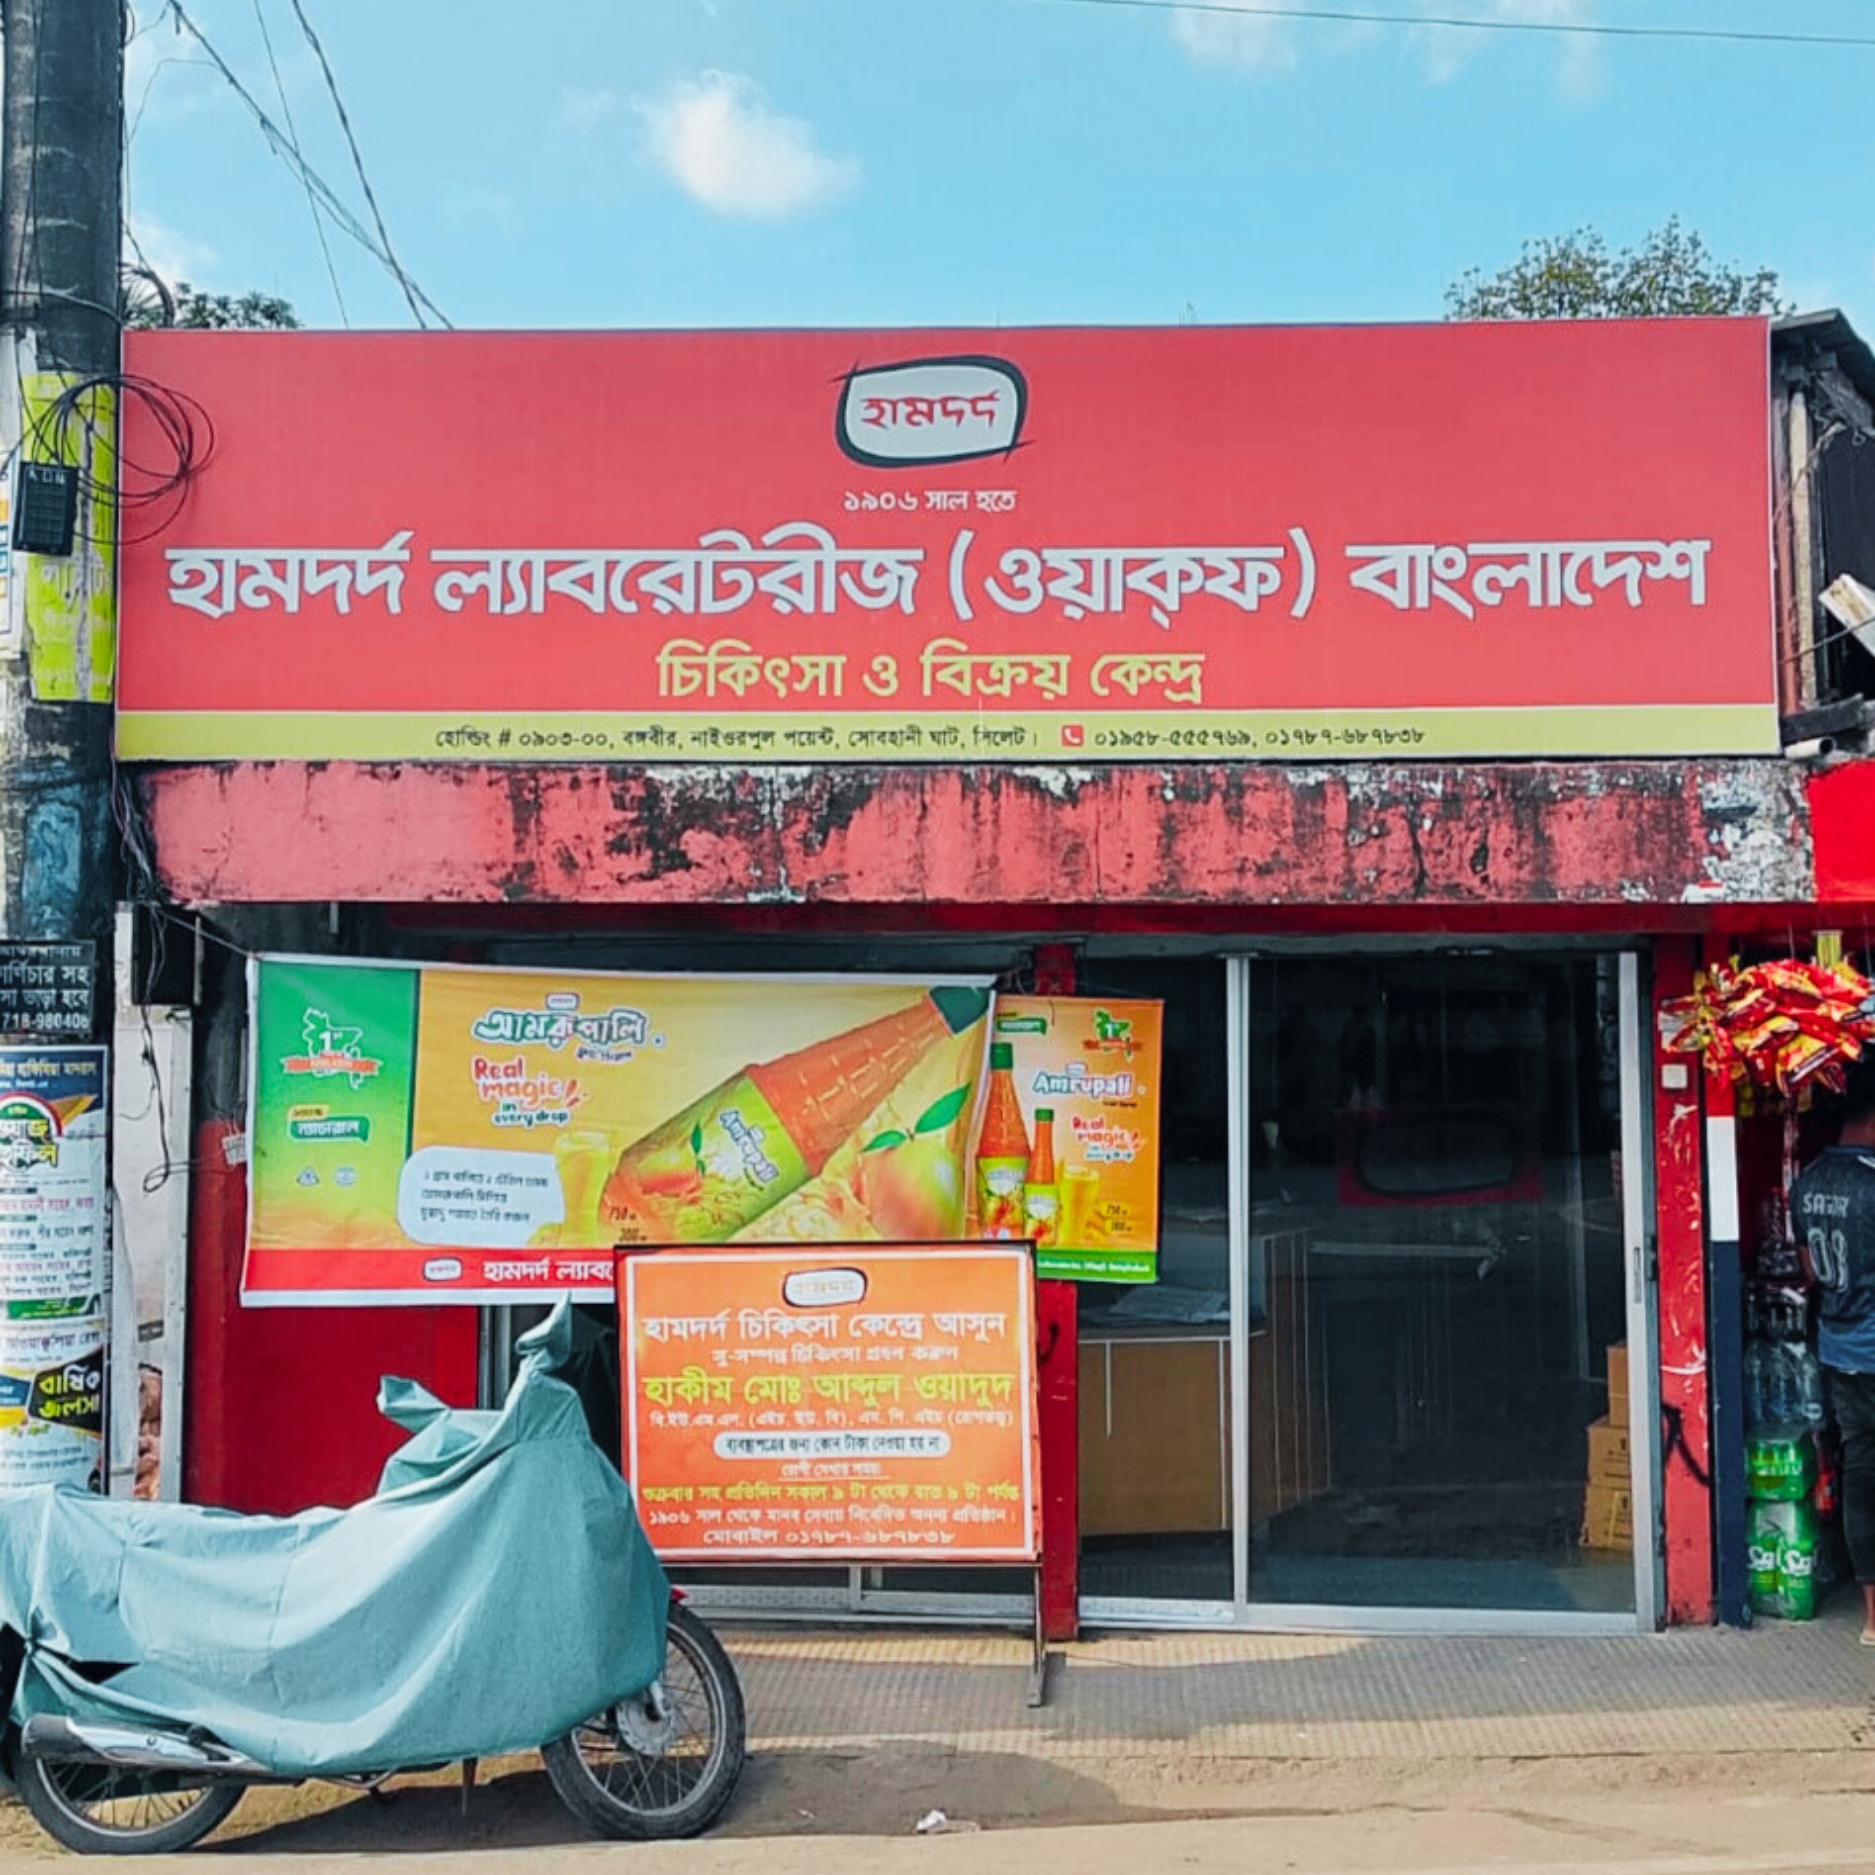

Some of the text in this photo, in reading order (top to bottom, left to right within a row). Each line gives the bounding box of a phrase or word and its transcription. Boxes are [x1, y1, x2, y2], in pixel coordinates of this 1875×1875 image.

[860, 389, 1001, 430] হামদর্দ
[844, 489, 1018, 512] ১৯০৬ সাল হতে
[166, 531, 413, 618] হামদর্দ
[430, 521, 924, 616] ল্যাবরেটরীজ
[1346, 539, 1712, 619] বাংলাদেশ
[656, 637, 1206, 704] চিকিৎসা ও বিক্রয় কেন্দ্র
[928, 725, 966, 750] ঘাট,
[474, 1057, 523, 1081] Real
[1033, 1070, 1132, 1099] Amrupali
[483, 1256, 551, 1282] হামদর্দ
[641, 1308, 731, 1343] হামদর্দ
[848, 1311, 925, 1341] কেন্দ্রে
[931, 1311, 1008, 1343] আসুন
[641, 1366, 1016, 1411] হাকীম মোঃ আব্দুল ওয়াদুদ
[702, 1527, 778, 1545] মোবাইল
